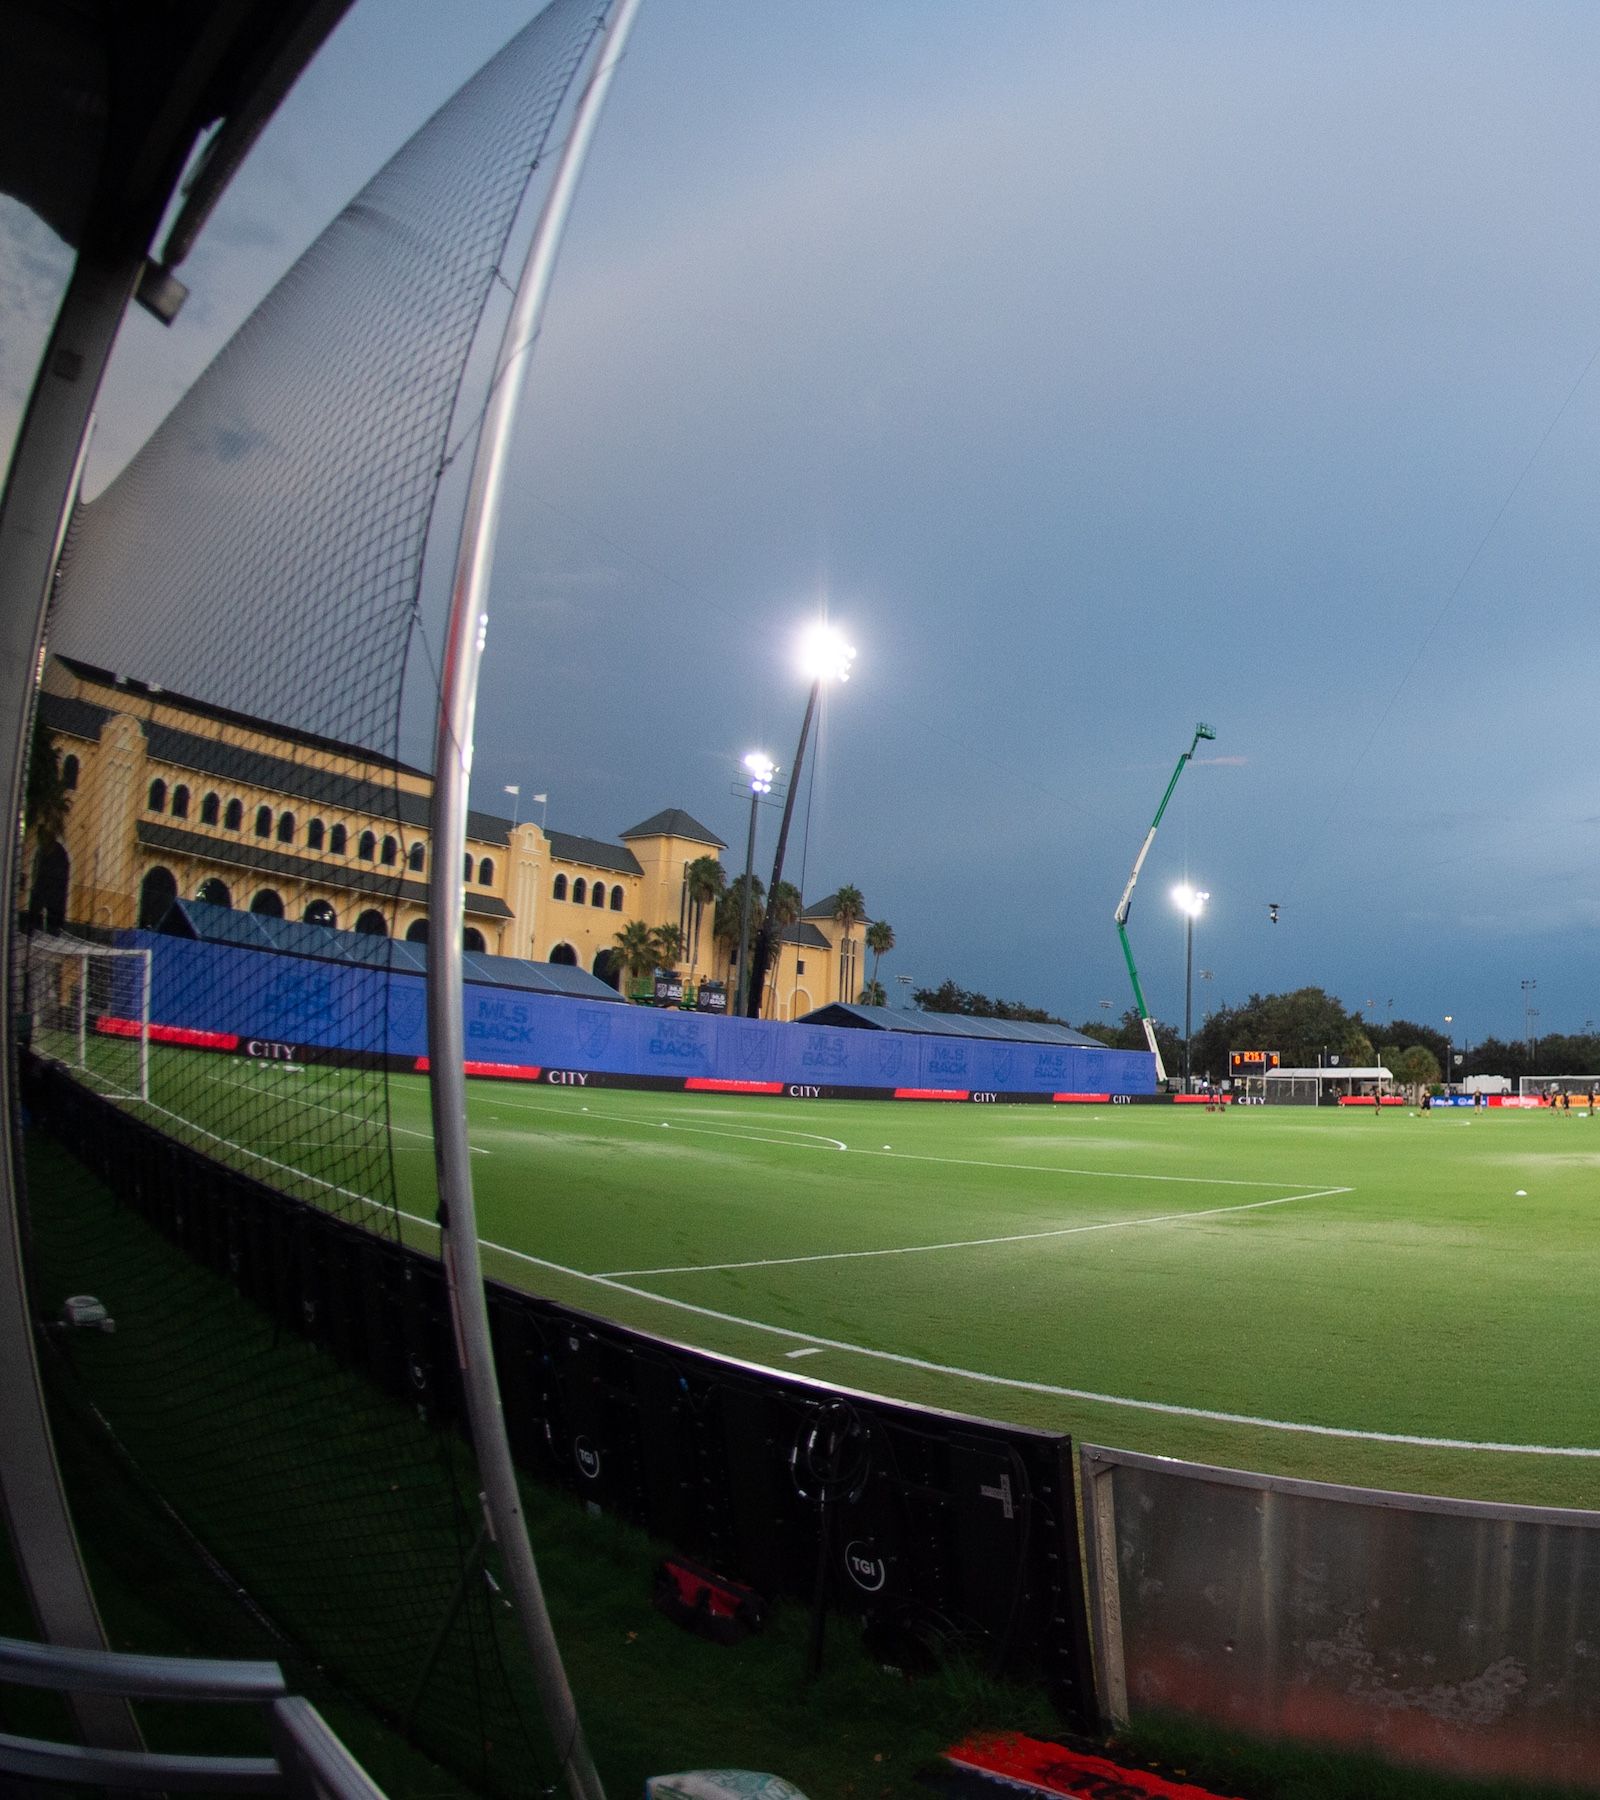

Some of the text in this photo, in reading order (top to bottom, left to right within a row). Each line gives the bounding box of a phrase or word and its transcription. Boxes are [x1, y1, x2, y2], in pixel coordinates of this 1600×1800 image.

[478, 1001, 529, 1024] MLS
[468, 1020, 534, 1043] BACK
[247, 1041, 296, 1059] CITY
[649, 1038, 707, 1058] BACK
[808, 1036, 845, 1052] MLS
[802, 1051, 849, 1068] BACK
[935, 1046, 963, 1061] MLS
[1038, 1054, 1063, 1067] MLS
[928, 1060, 968, 1074] BACK
[1034, 1066, 1067, 1080] BACK
[548, 1071, 589, 1085] CITY
[790, 1085, 821, 1098] CITY
[974, 1092, 998, 1103] CITY
[1113, 1095, 1132, 1104] CITY
[1238, 1096, 1266, 1105] CITY
[579, 1448, 594, 1465] TGI
[852, 1556, 875, 1576] TGI
